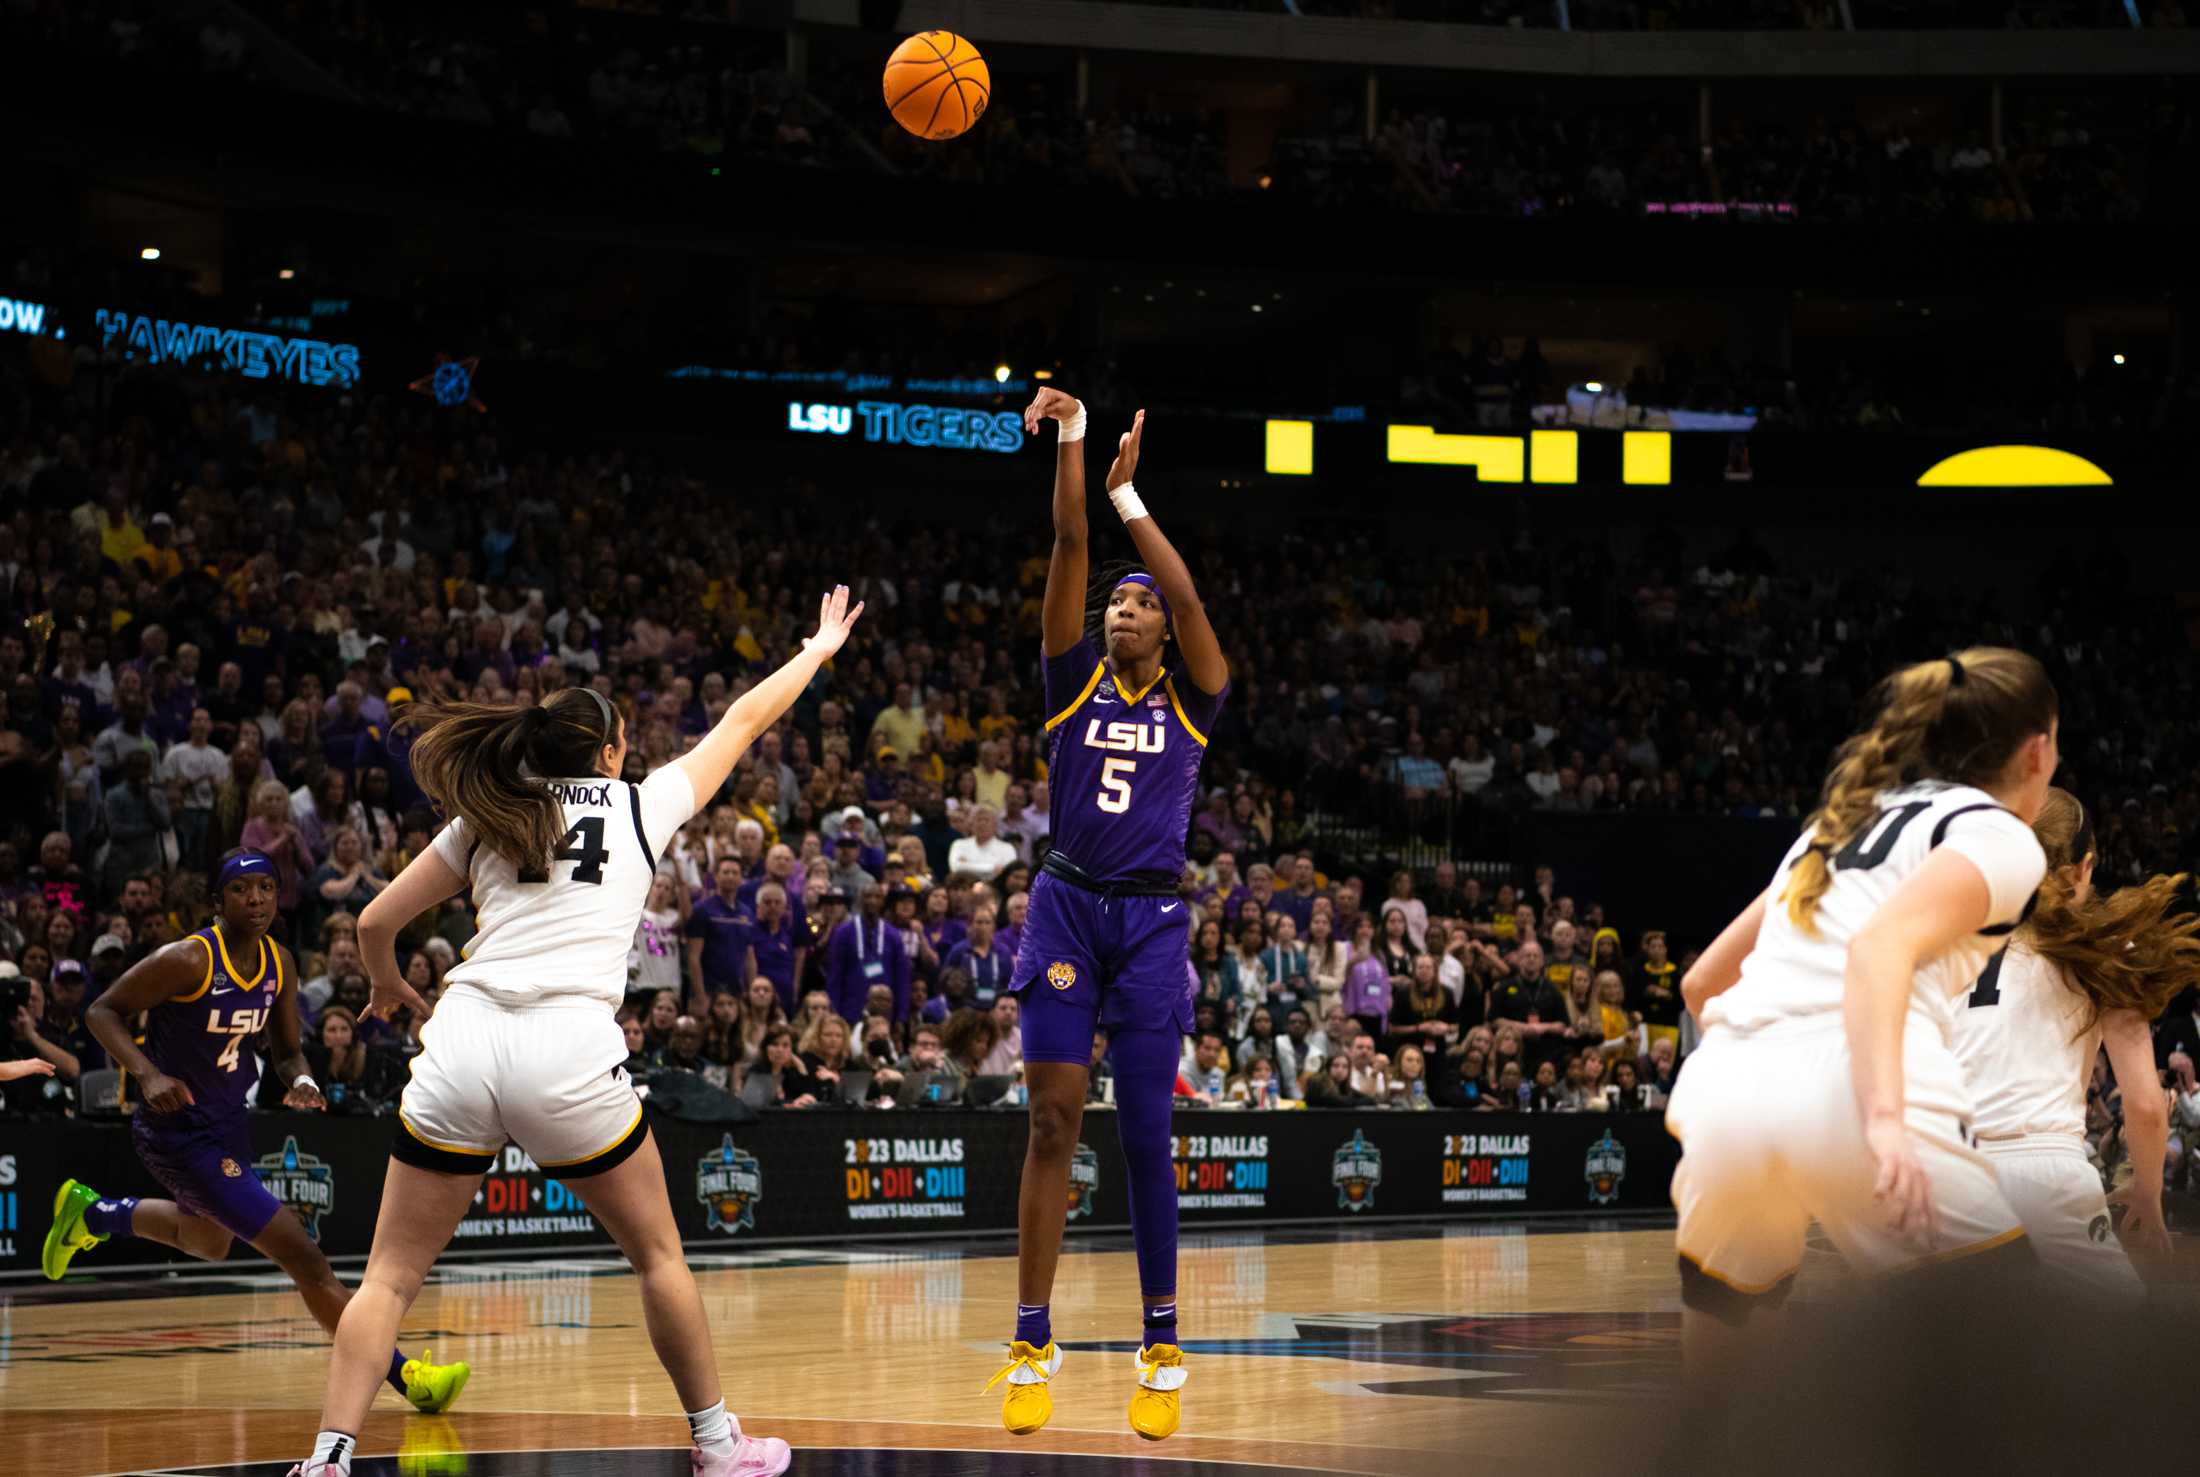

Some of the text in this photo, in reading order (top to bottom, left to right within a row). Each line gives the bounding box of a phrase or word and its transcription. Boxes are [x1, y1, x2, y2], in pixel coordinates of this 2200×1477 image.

[789, 400, 1024, 452] LSU TIGERS
[1083, 718, 1165, 753] LSU
[1097, 757, 1137, 814] 5
[517, 816, 610, 885] 4
[207, 1008, 271, 1034] LSU
[217, 1033, 245, 1073] 4
[893, 1138, 964, 1162] DALLAS
[1210, 1136, 1268, 1157] DALLAS
[1479, 1135, 1530, 1156] DALLAS
[846, 1167, 965, 1199] DI DII DIII
[1199, 1163, 1224, 1190] DII
[1235, 1162, 1268, 1189] DIII
[1443, 1158, 1529, 1185] DI DII DIII
[291, 1180, 328, 1206] FOUR
[488, 1178, 528, 1214] DII
[1177, 1195, 1209, 1209] OMEN'S
[899, 1202, 965, 1218] BASKETBALL
[507, 1216, 594, 1235] BASKETBALL
